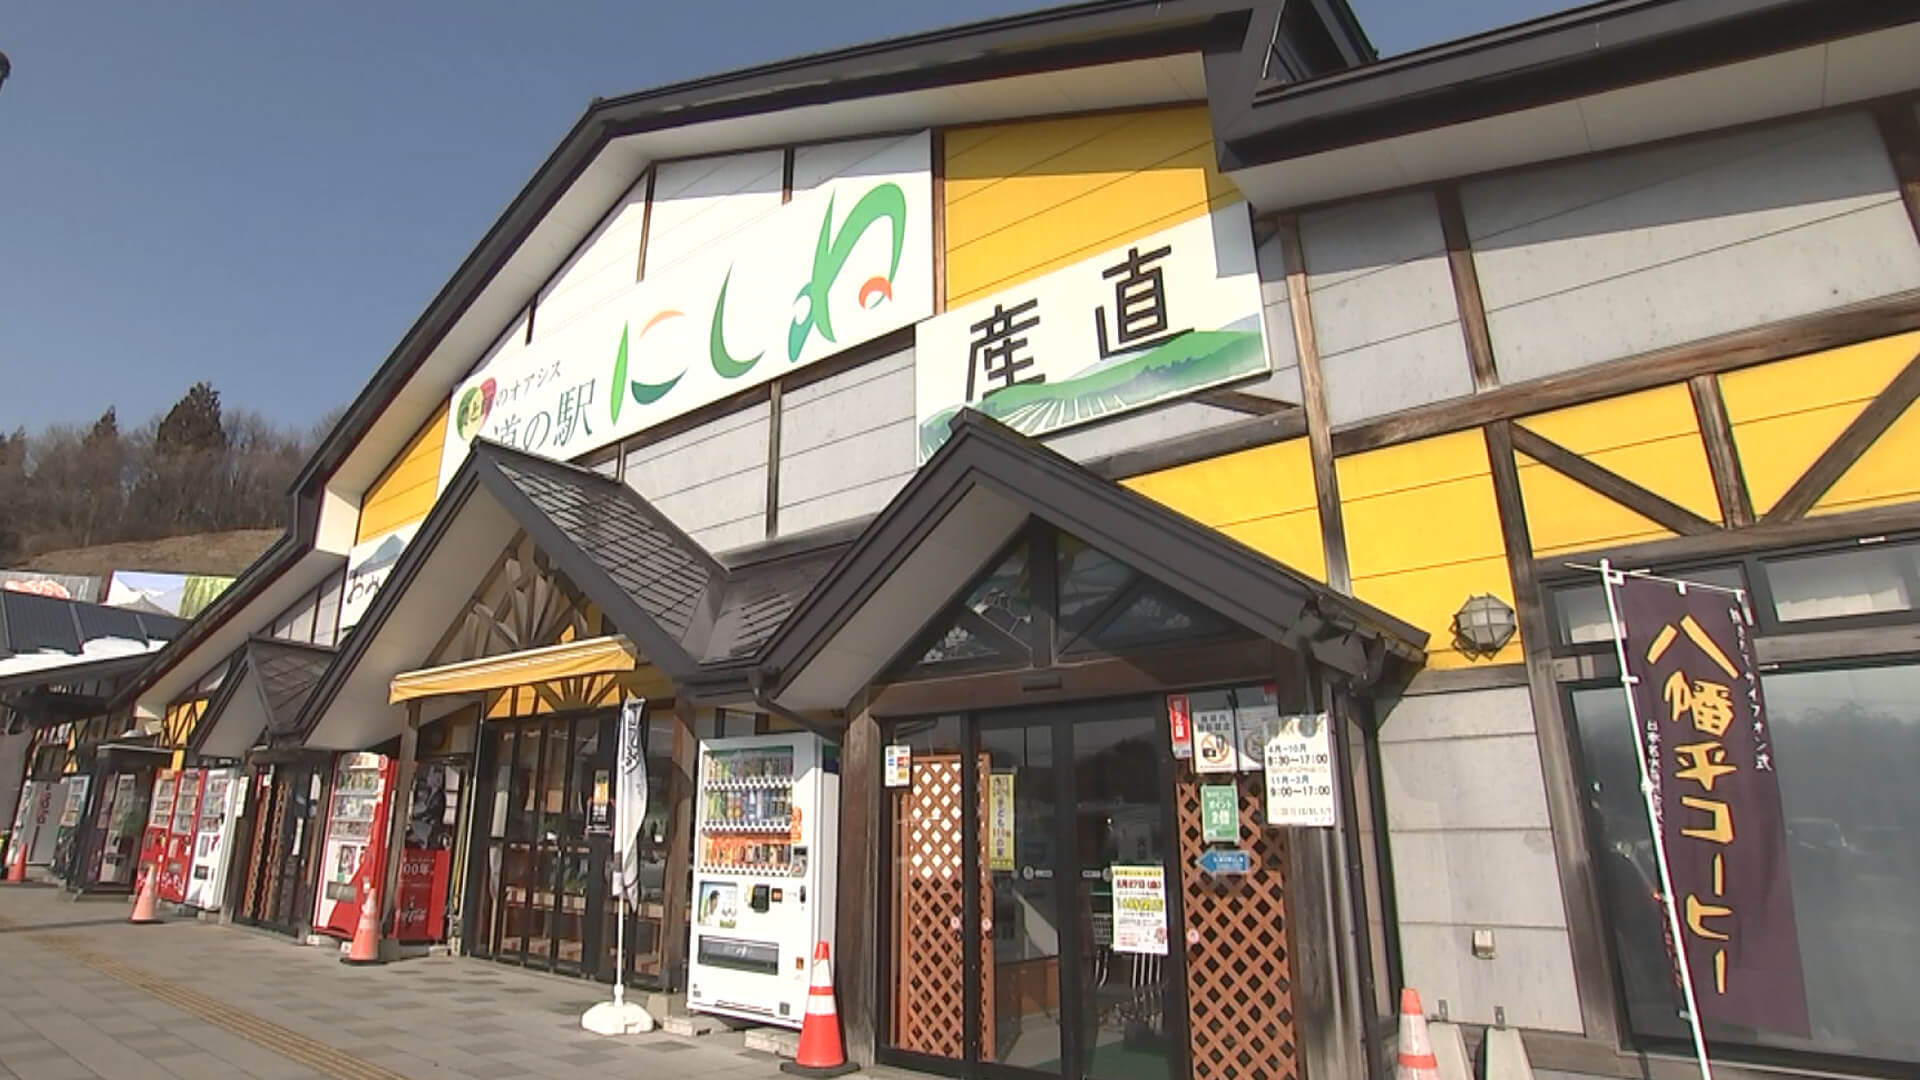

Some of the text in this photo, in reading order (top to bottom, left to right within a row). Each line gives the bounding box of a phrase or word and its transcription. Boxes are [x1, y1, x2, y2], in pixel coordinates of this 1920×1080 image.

[966, 245, 1195, 401] 産直
[494, 377, 596, 451] 道の駅
[1647, 615, 1739, 994] 八幡平コーヒー
